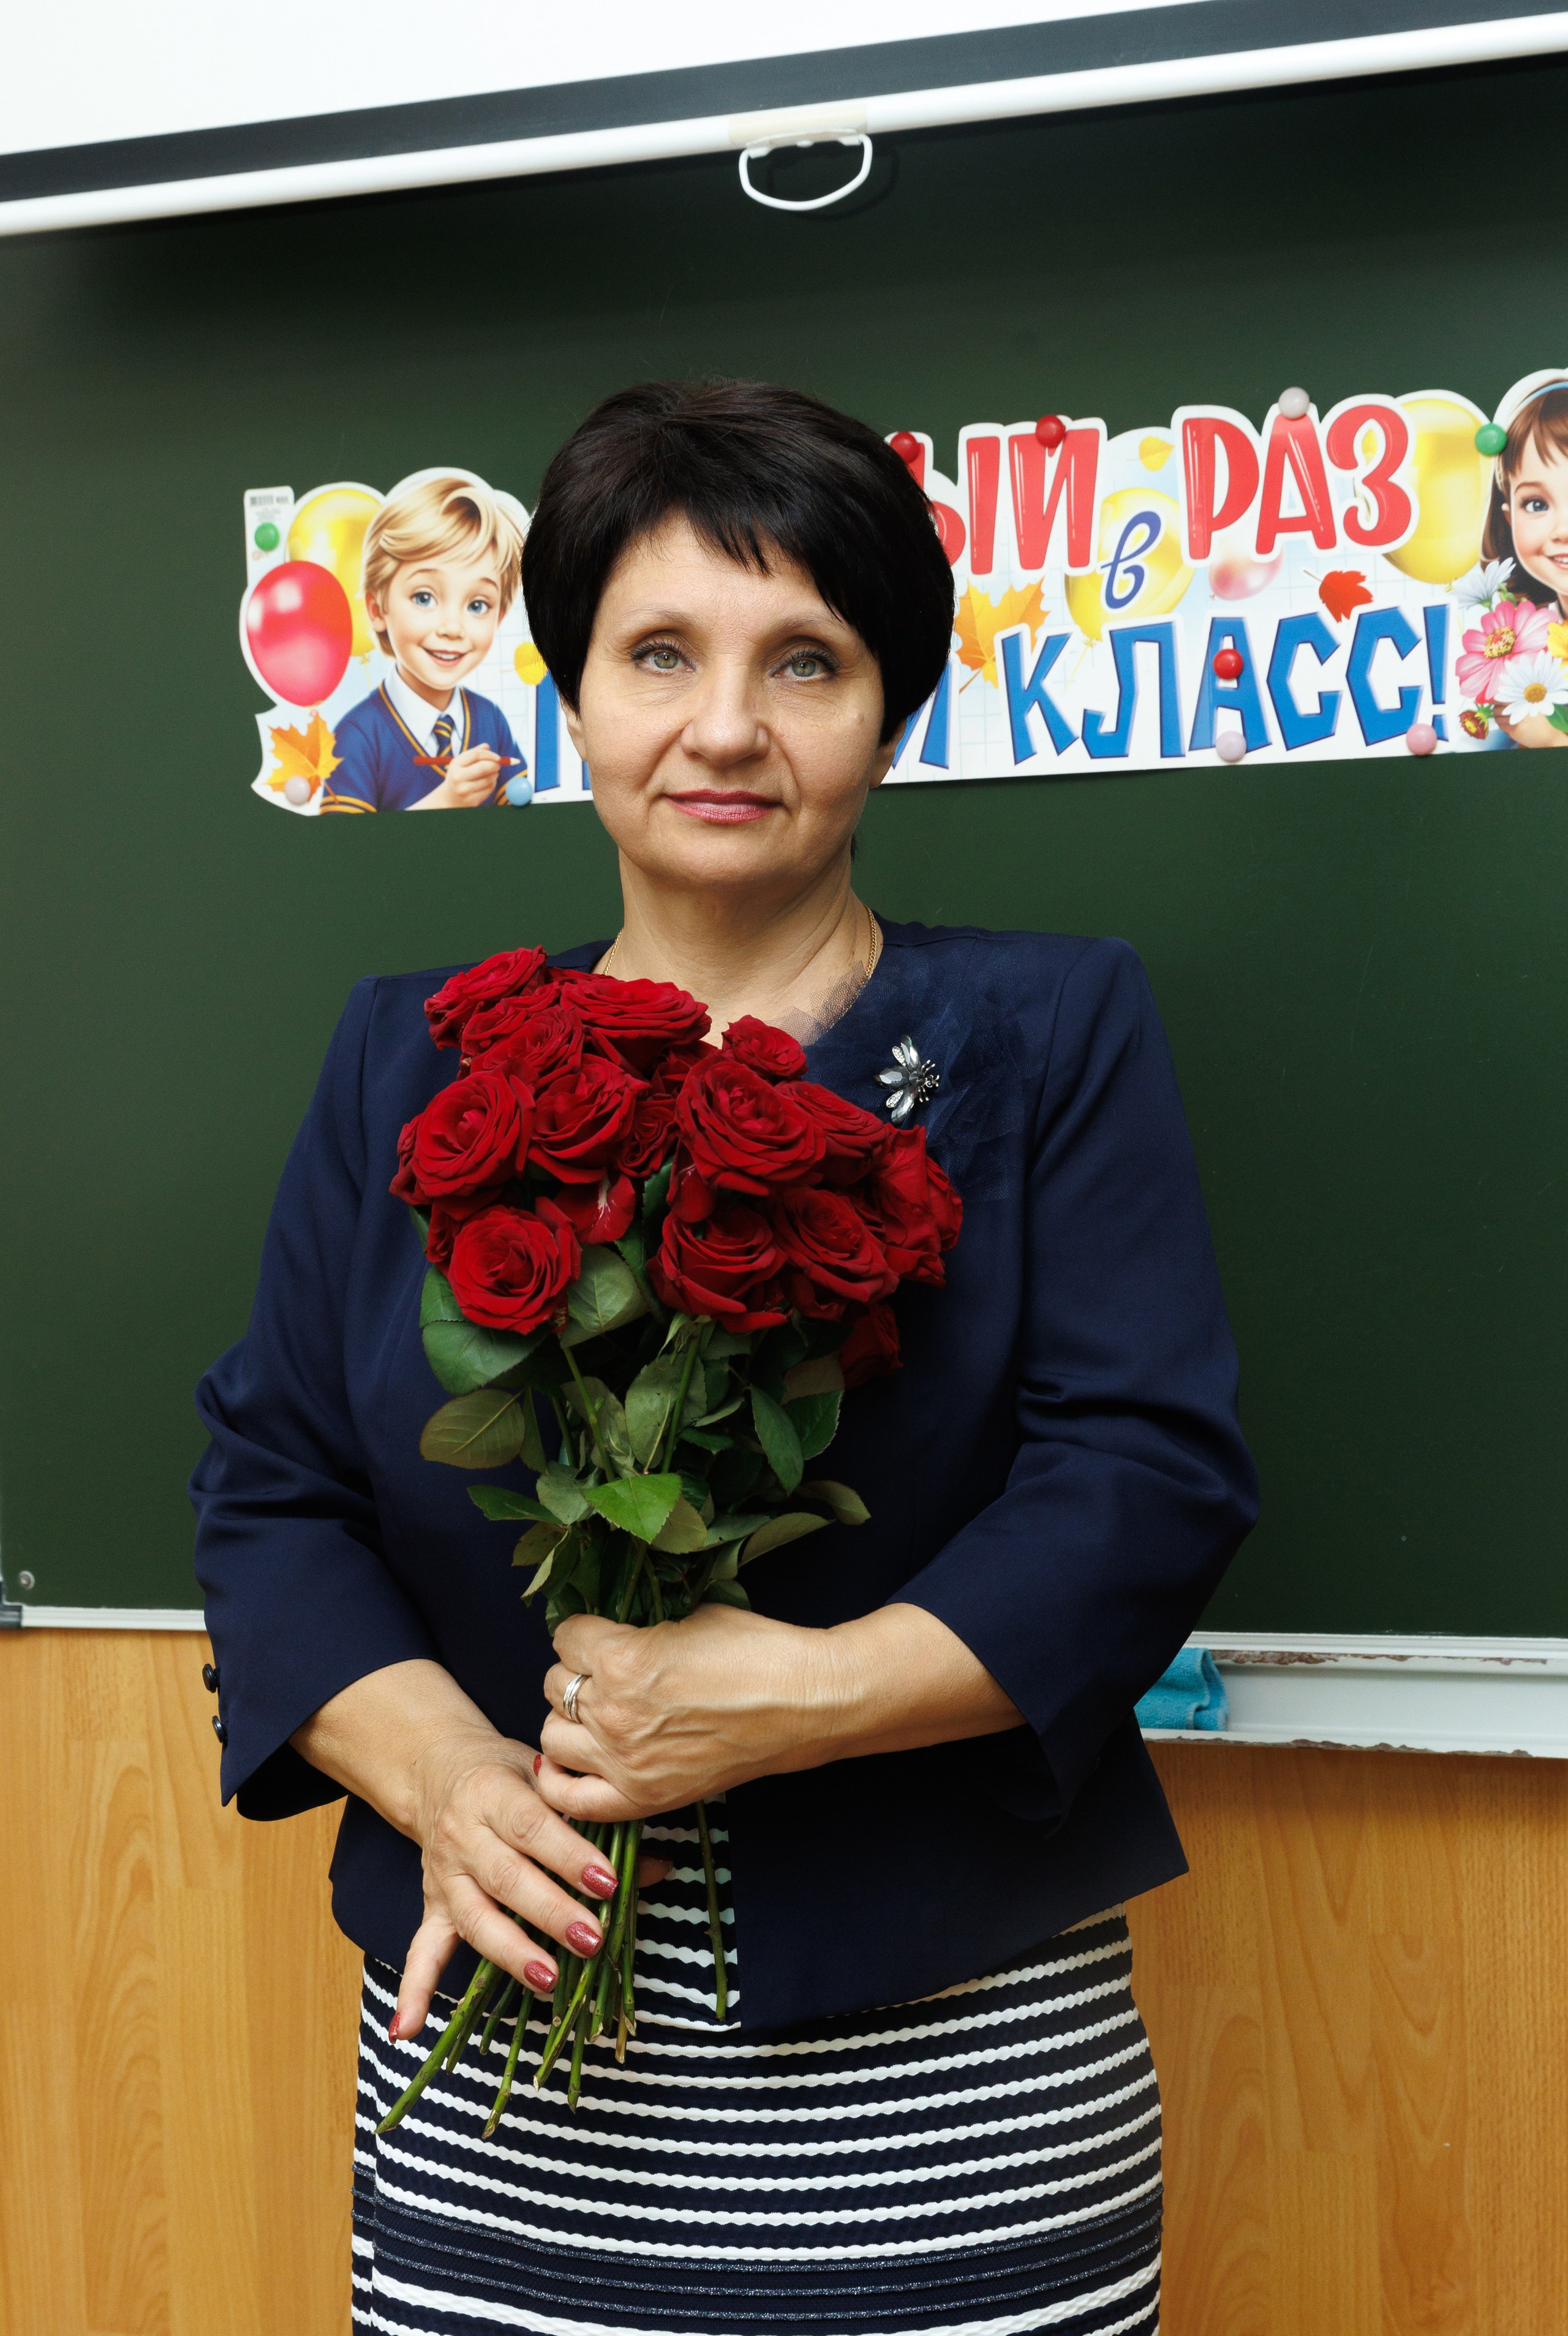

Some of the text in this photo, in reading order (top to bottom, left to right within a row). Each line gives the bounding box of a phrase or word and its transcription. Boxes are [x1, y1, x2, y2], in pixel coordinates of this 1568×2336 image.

[1099, 510, 1163, 609] в
[1181, 404, 1412, 560] РАЗ
[1001, 603, 1450, 766] КЛАСС!
